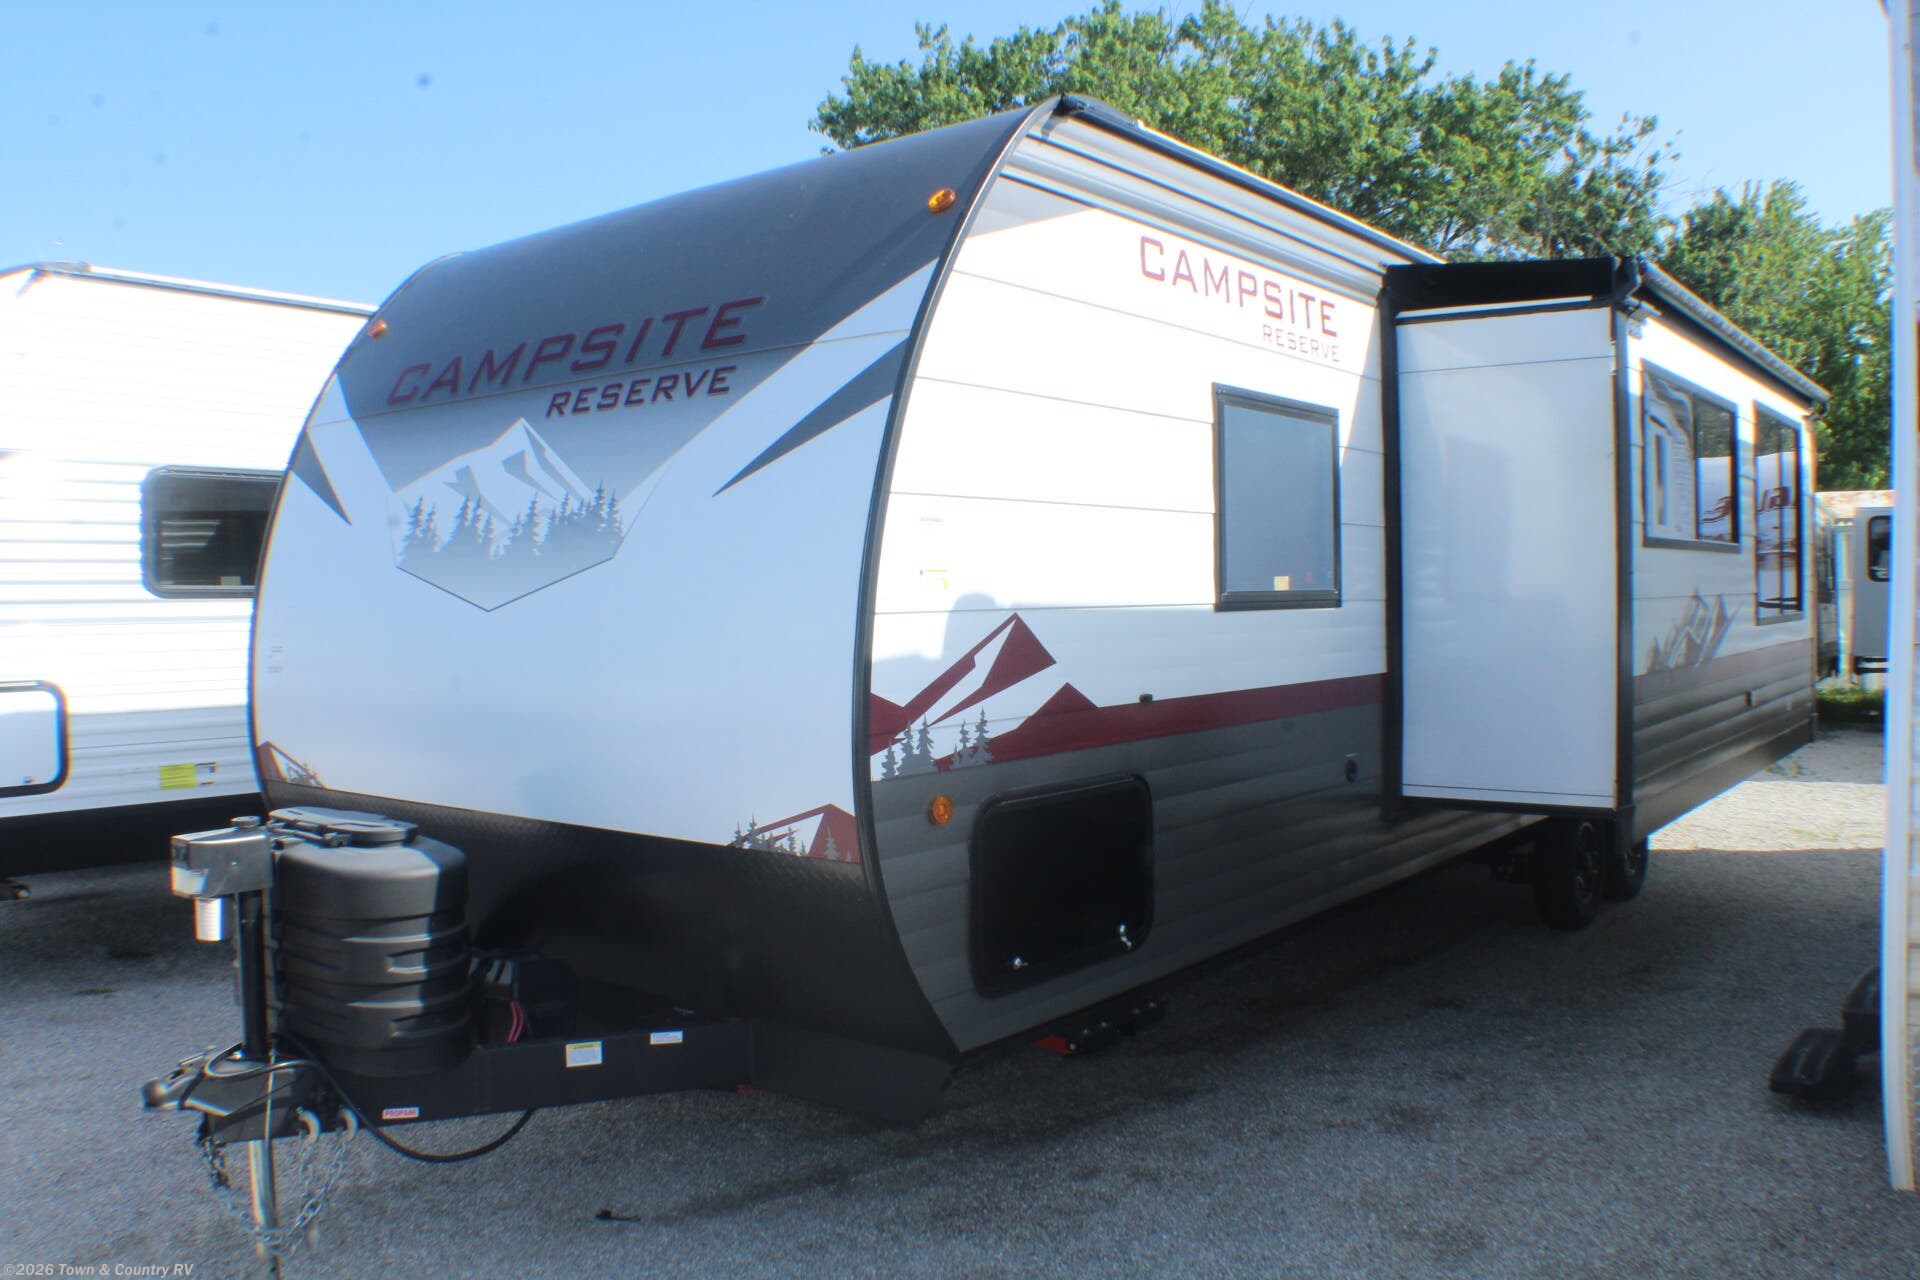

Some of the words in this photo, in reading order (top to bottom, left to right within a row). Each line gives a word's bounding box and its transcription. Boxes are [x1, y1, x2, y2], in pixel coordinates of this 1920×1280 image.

[1140, 236, 1337, 337] CAMPSITE
[386, 296, 765, 405] CAMPSITE
[1262, 324, 1340, 363] RESERVE
[546, 365, 737, 418] RESERVE
[384, 1109, 418, 1118] PROPANE
